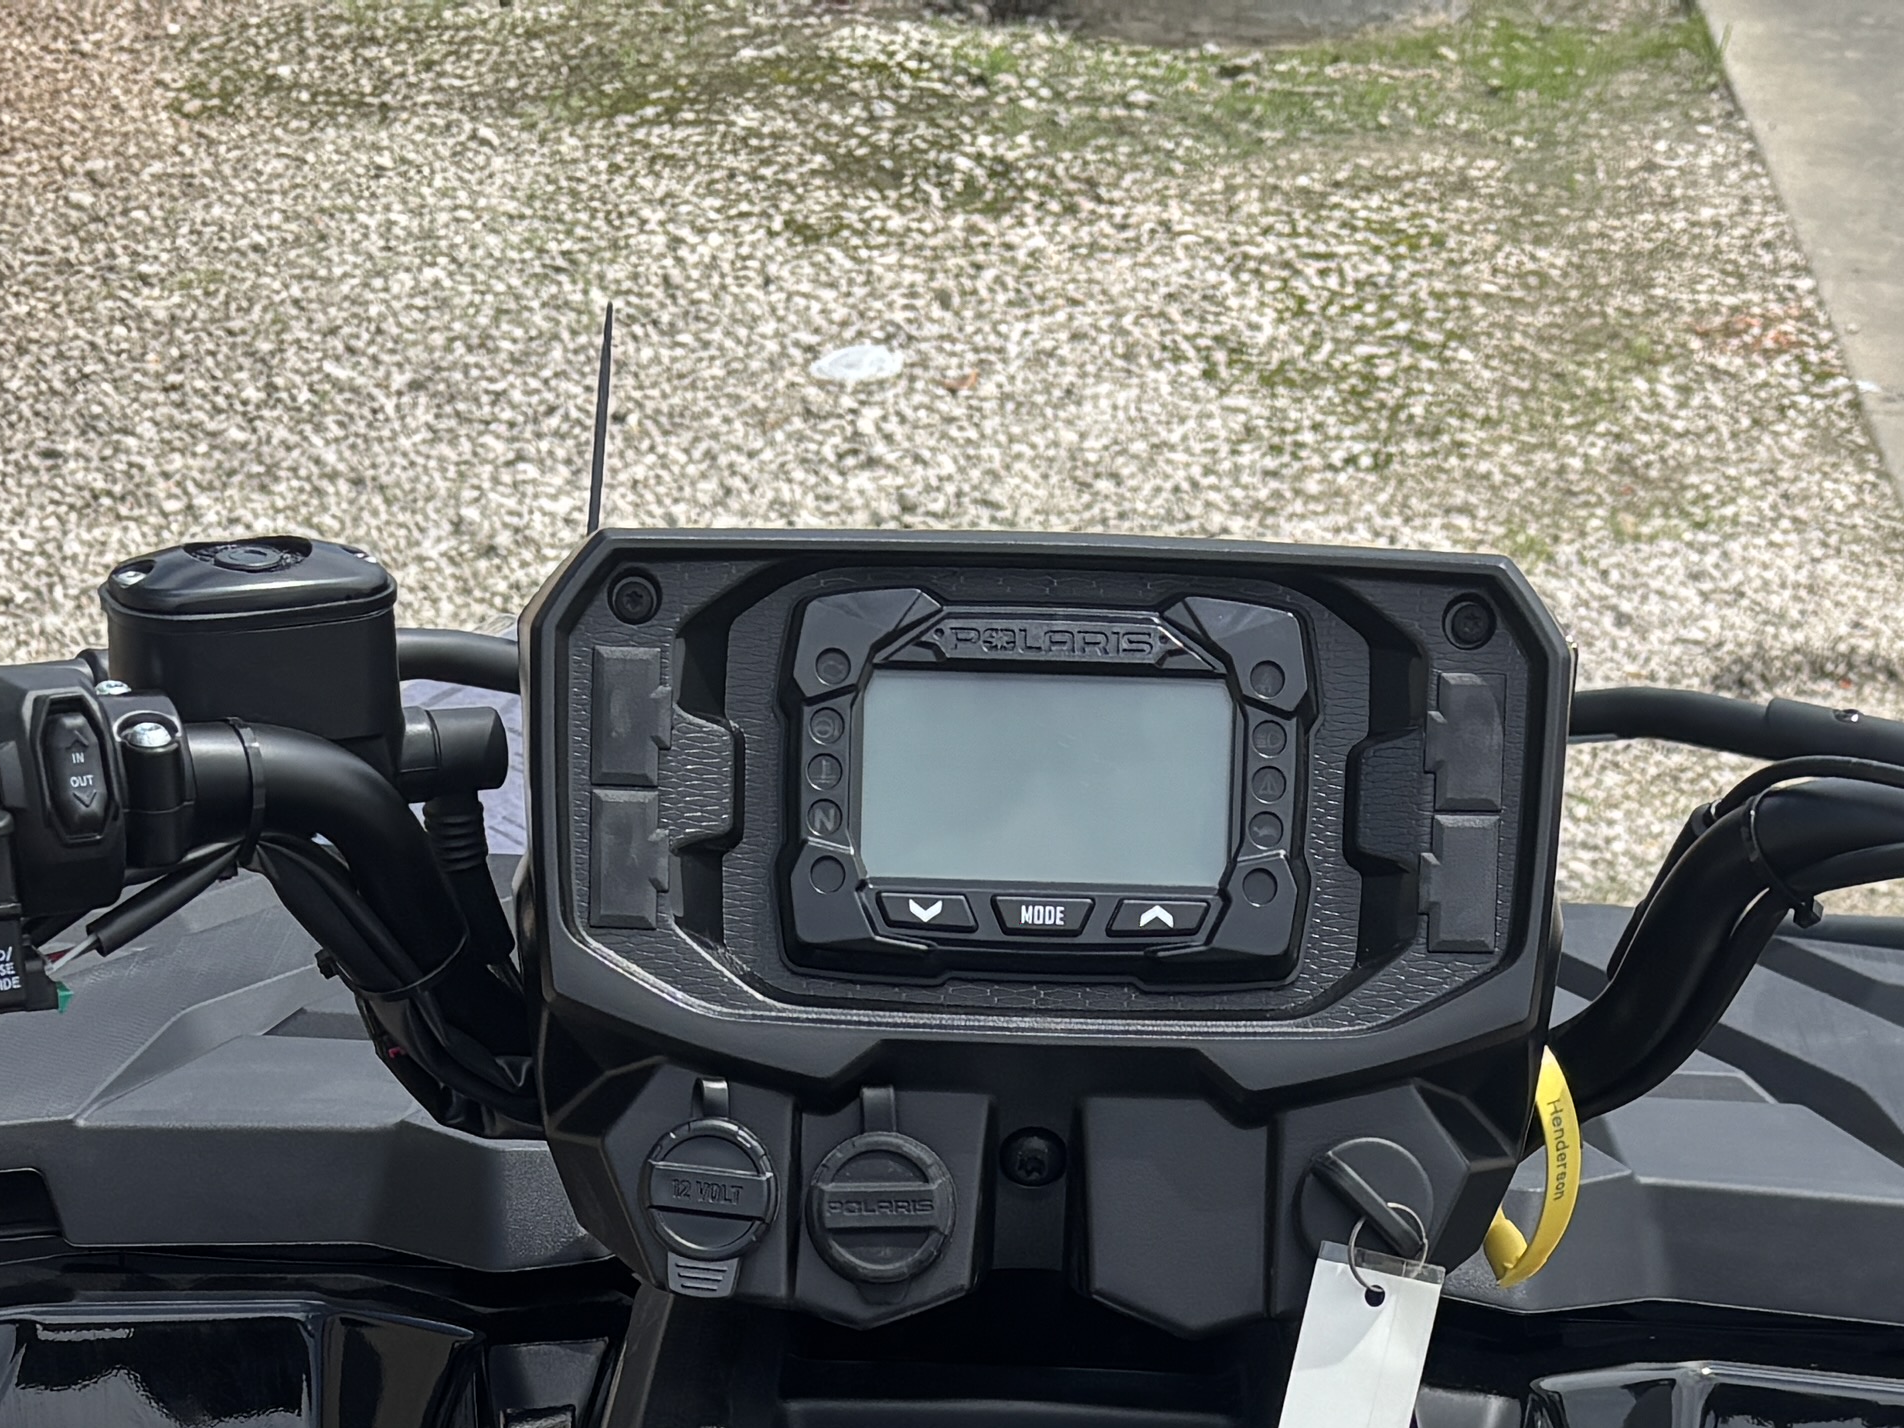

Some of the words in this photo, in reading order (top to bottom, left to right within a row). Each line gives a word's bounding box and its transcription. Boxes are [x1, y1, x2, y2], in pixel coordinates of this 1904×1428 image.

[950, 626, 1154, 656] POLARIS
[72, 752, 84, 764] IN
[70, 774, 94, 788] OUT
[1021, 904, 1065, 926] MODE
[1547, 1099, 1569, 1201] Henderson
[671, 1179, 690, 1200] 12
[695, 1180, 744, 1206] VOLT
[826, 1199, 935, 1217] POLARIS
